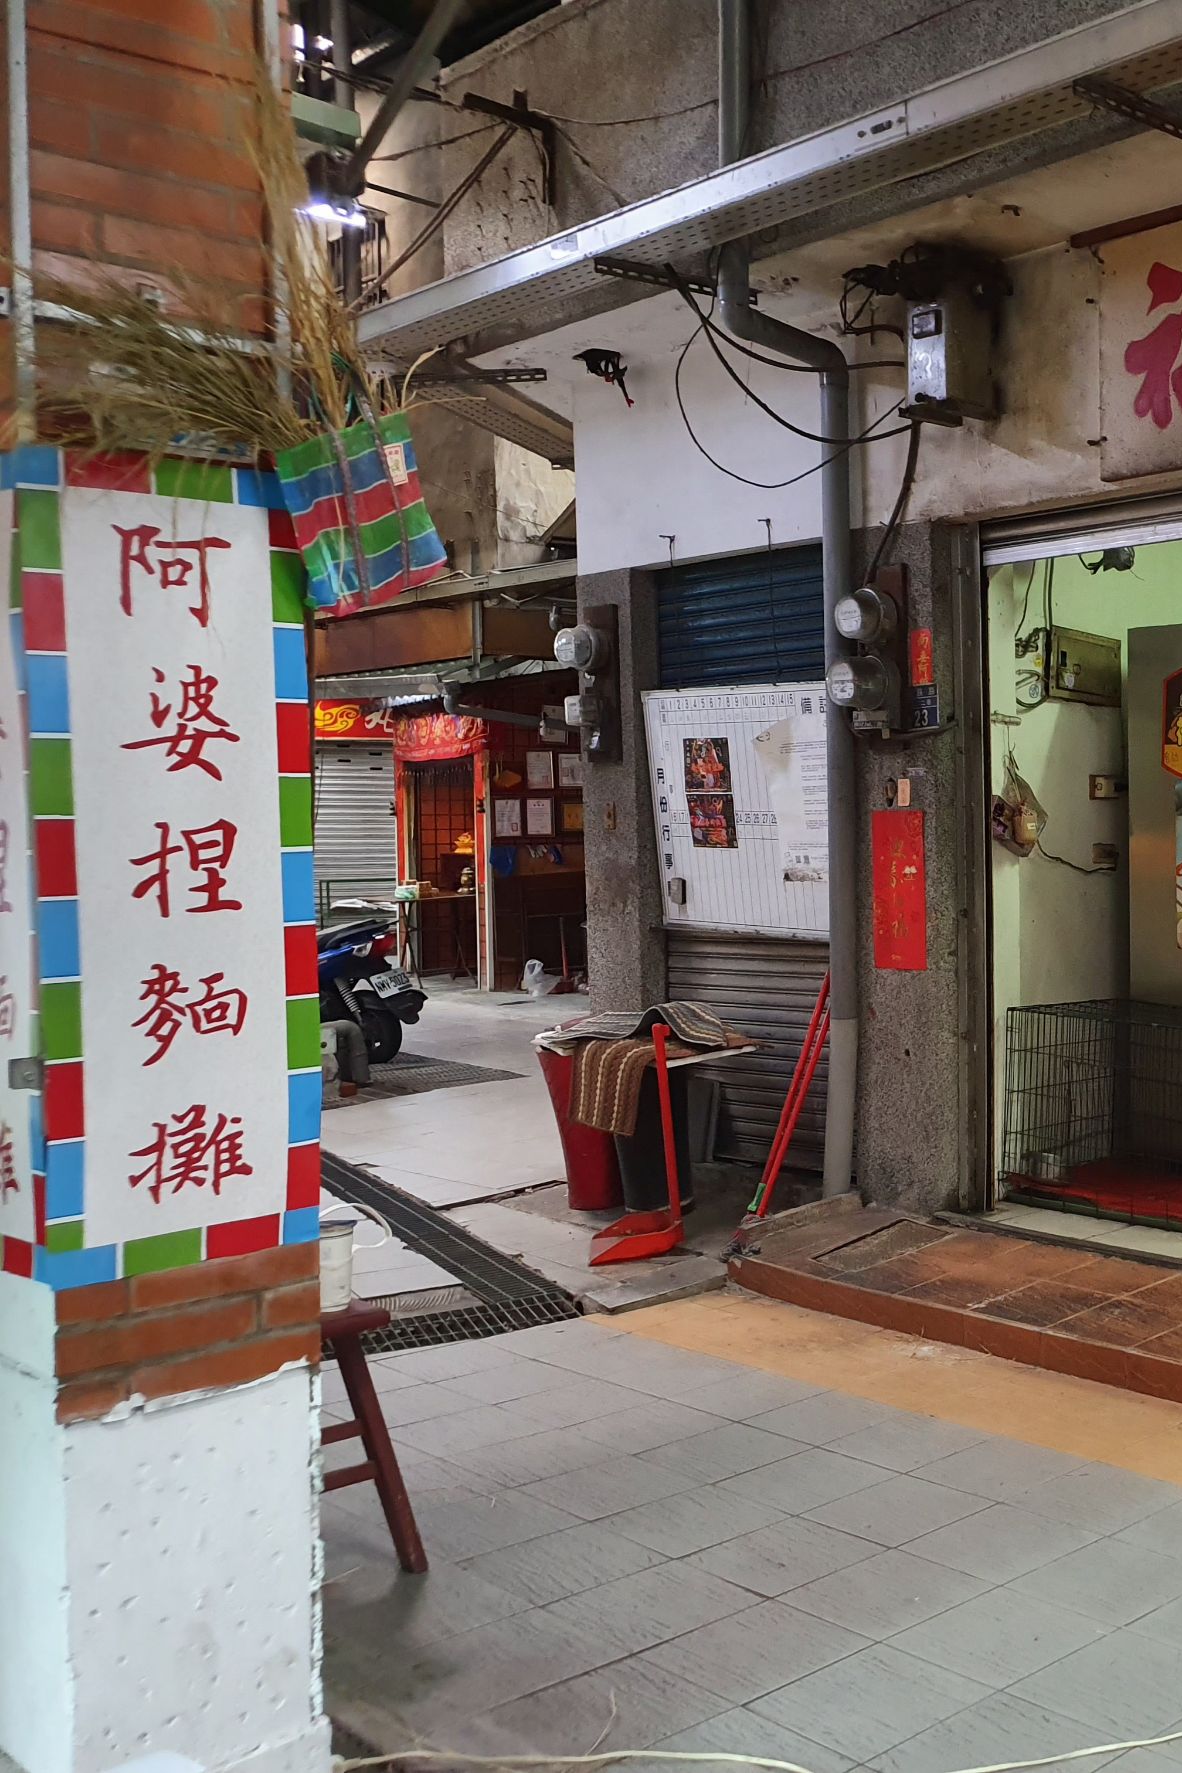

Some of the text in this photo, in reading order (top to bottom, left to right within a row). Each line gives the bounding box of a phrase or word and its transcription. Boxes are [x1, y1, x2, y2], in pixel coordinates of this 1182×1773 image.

[110, 523, 253, 1204] 阿婆捏麵攤
[914, 709, 929, 727] 23
